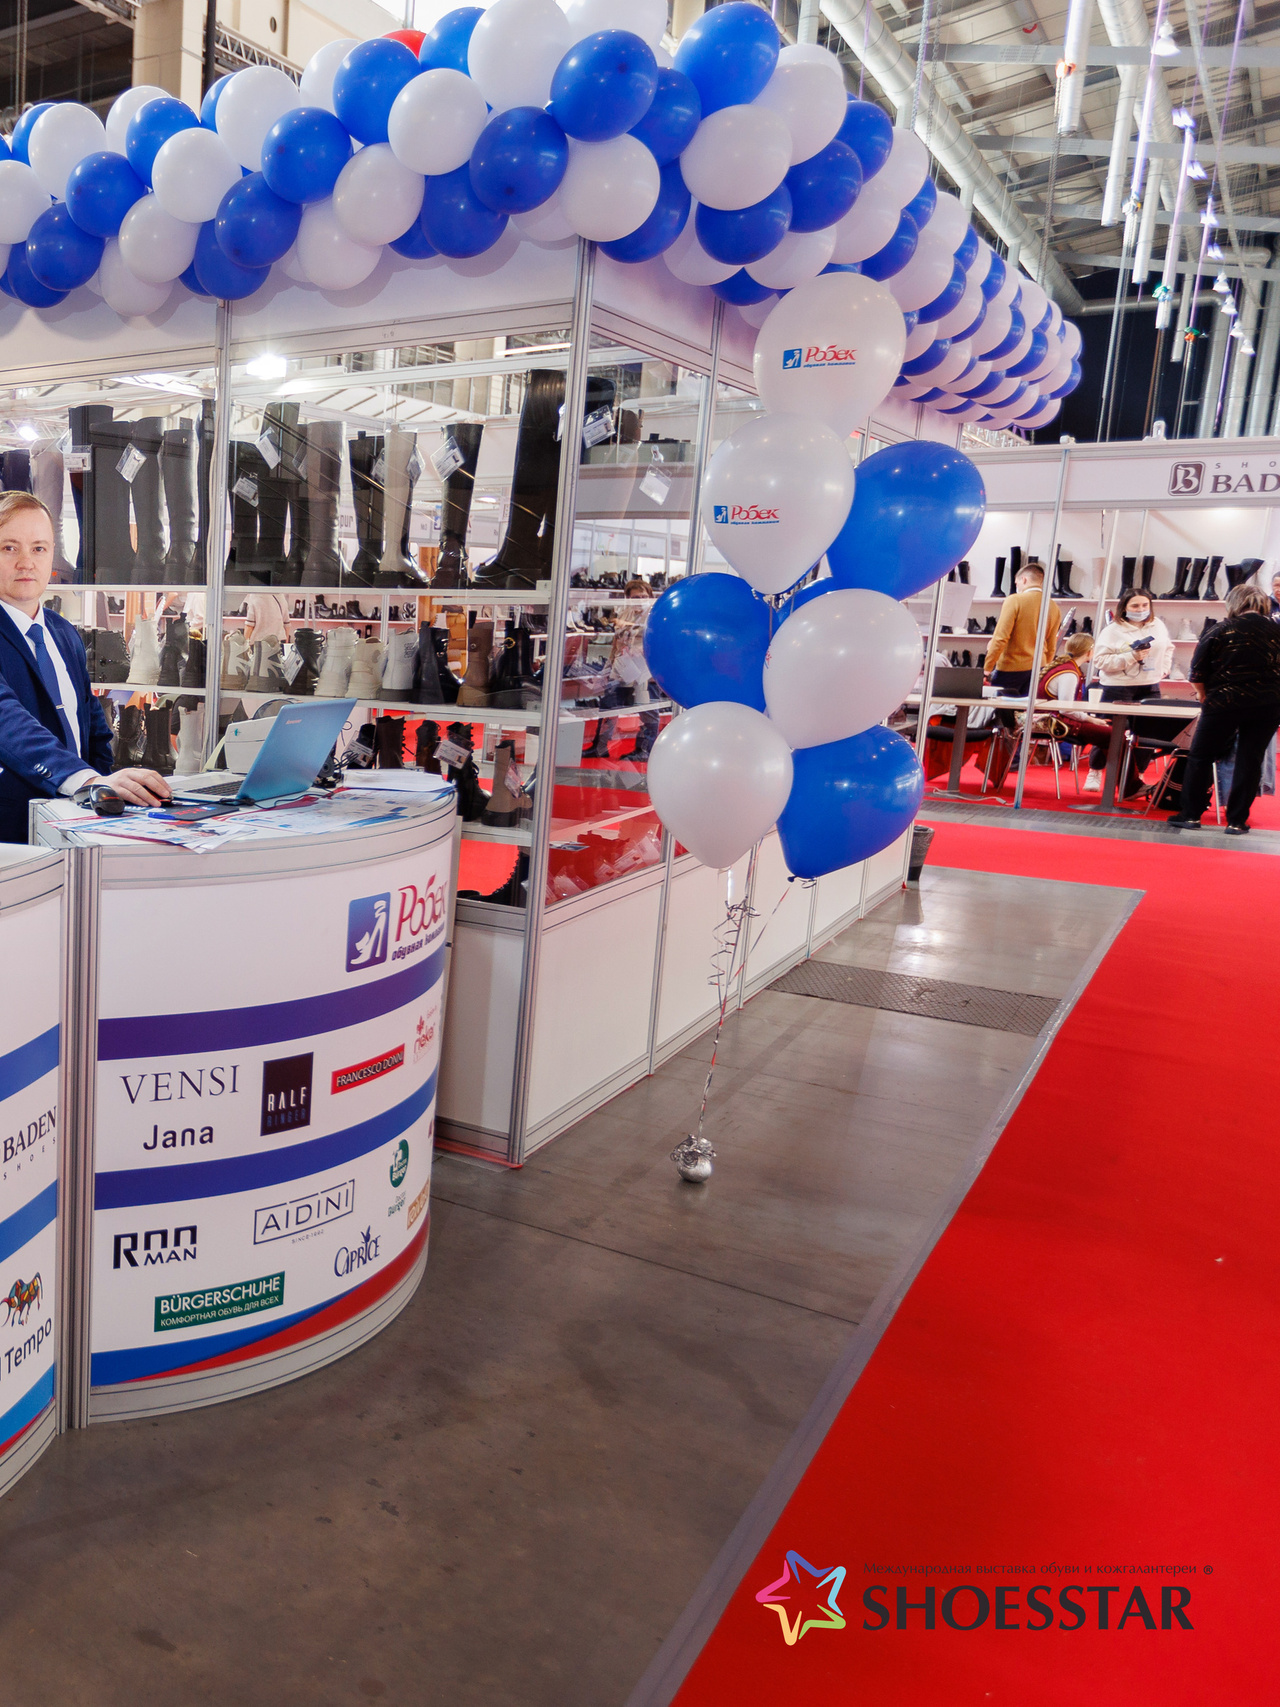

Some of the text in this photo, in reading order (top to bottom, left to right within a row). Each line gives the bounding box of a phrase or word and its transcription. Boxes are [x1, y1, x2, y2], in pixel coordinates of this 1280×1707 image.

[805, 344, 858, 362] Робек
[731, 504, 780, 520] Робек
[120, 1064, 240, 1105] VENSI
[267, 1086, 307, 1112] RALF
[2, 1105, 57, 1164] BADEN
[143, 1124, 214, 1150] Jana
[261, 1188, 349, 1235] AIDINI
[144, 1246, 197, 1266] MAN
[160, 1276, 280, 1315] BÜRGERSCHUHE
[160, 1311, 217, 1327] КОМФОРТНАЯ
[217, 1304, 243, 1317] ОБУВЬ
[4, 1317, 53, 1375] Tempo
